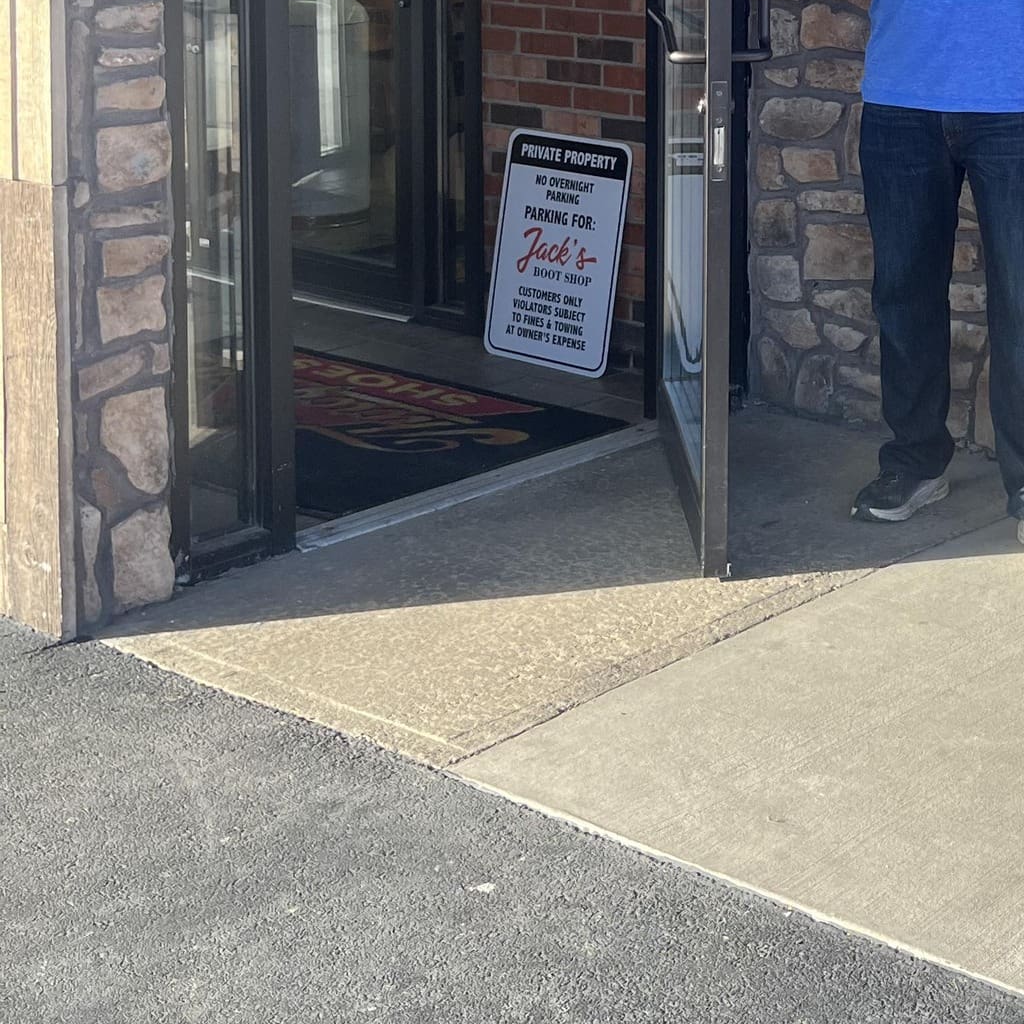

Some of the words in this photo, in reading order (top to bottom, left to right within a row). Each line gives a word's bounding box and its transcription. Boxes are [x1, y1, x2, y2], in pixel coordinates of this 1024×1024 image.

[521, 143, 562, 163] PRIVATE
[564, 149, 618, 171] PROPERTY
[535, 174, 547, 186] NO
[549, 176, 595, 194] OVERNIGHT
[546, 189, 580, 205] PARKING
[524, 205, 568, 226] PARKING
[571, 213, 596, 231] FOR:
[517, 227, 597, 273] Jack's
[533, 266, 562, 282] BOOT
[564, 272, 592, 287] SHOP
[518, 285, 561, 304] CUSTOMERS
[563, 295, 583, 308] ONLY
[513, 298, 552, 316] VIOLATORS
[554, 306, 586, 322] SUBJECT
[512, 311, 522, 323] TO
[523, 314, 544, 328] FINES
[546, 319, 552, 330] &
[554, 321, 583, 337] TOWING
[505, 324, 515, 335] AT
[517, 326, 550, 343] OWNER'S
[552, 334, 586, 351] EXPENSE
